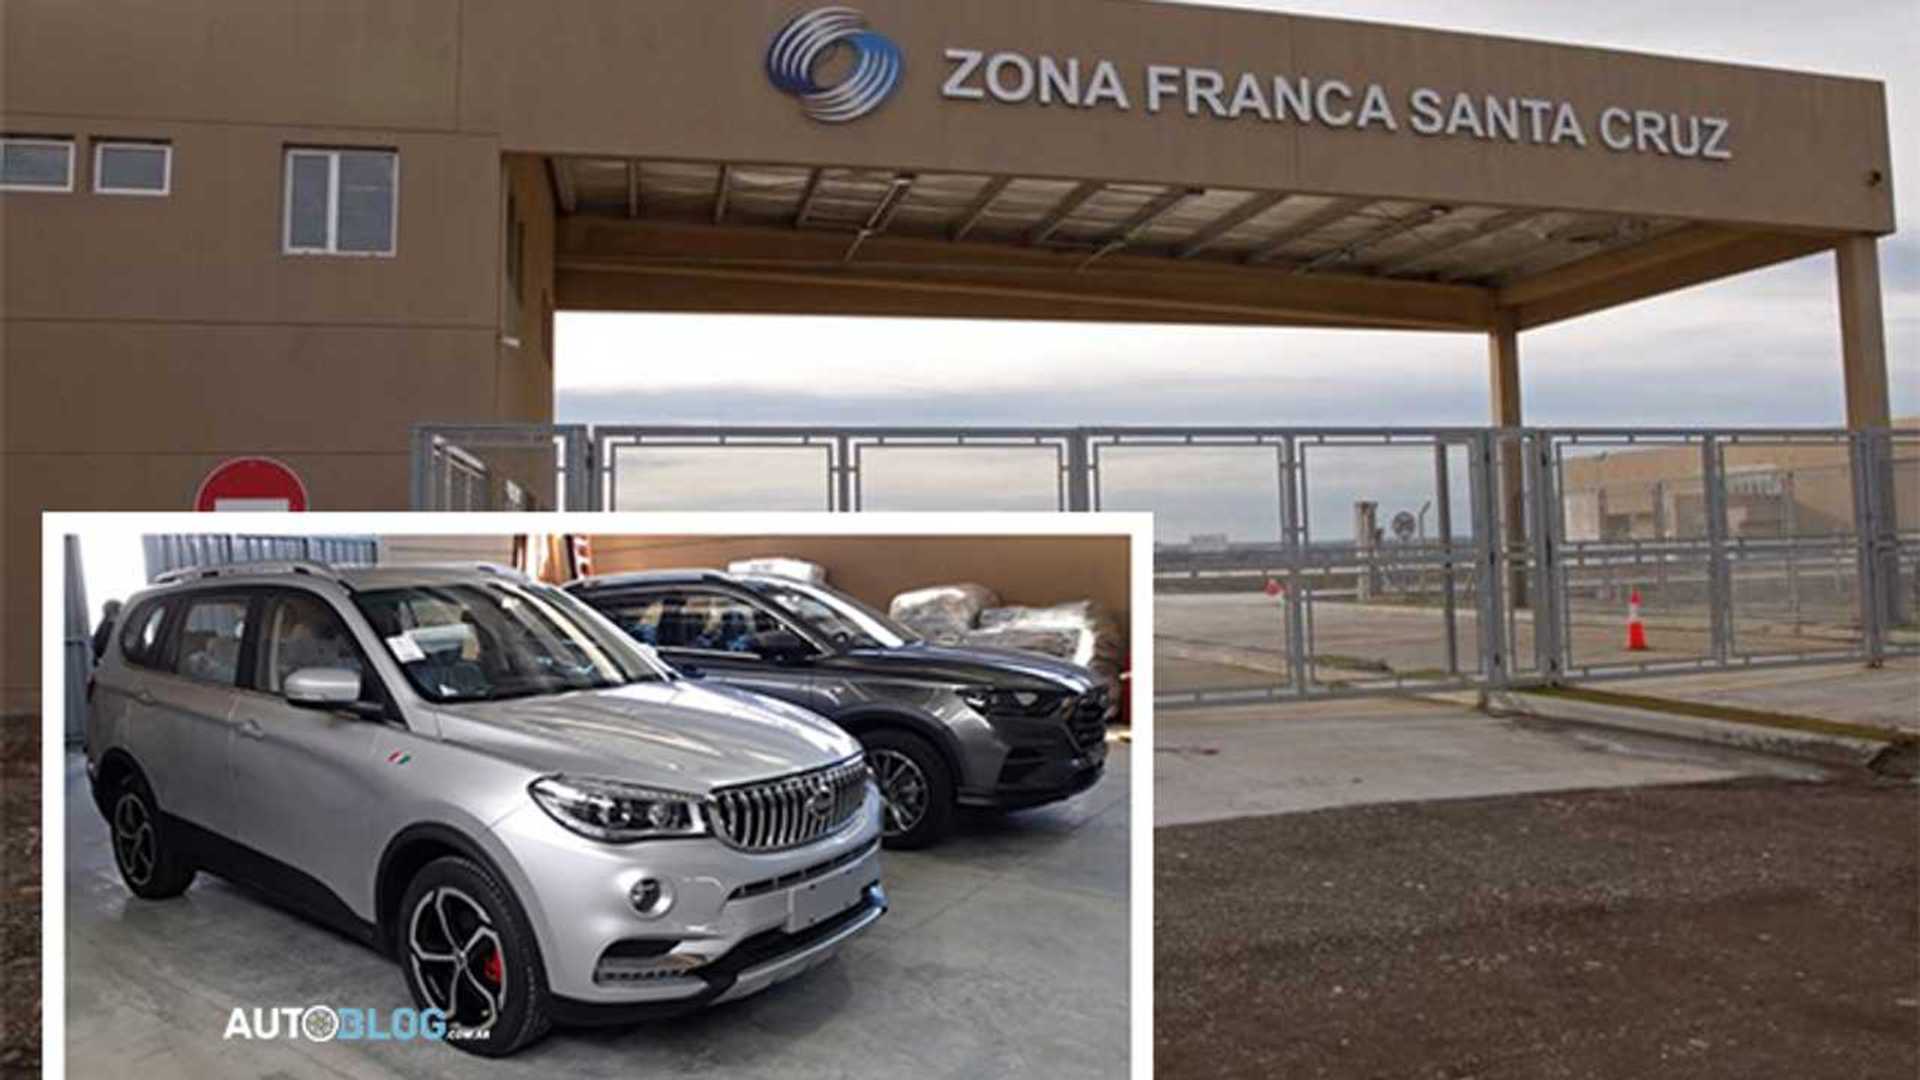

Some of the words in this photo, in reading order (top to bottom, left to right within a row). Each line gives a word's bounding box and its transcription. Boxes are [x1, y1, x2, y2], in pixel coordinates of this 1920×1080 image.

[942, 48, 1130, 109] ZONA
[1146, 65, 1397, 130] FRANCA
[1411, 88, 1587, 145] SANTA
[1600, 106, 1733, 159] CRUZ
